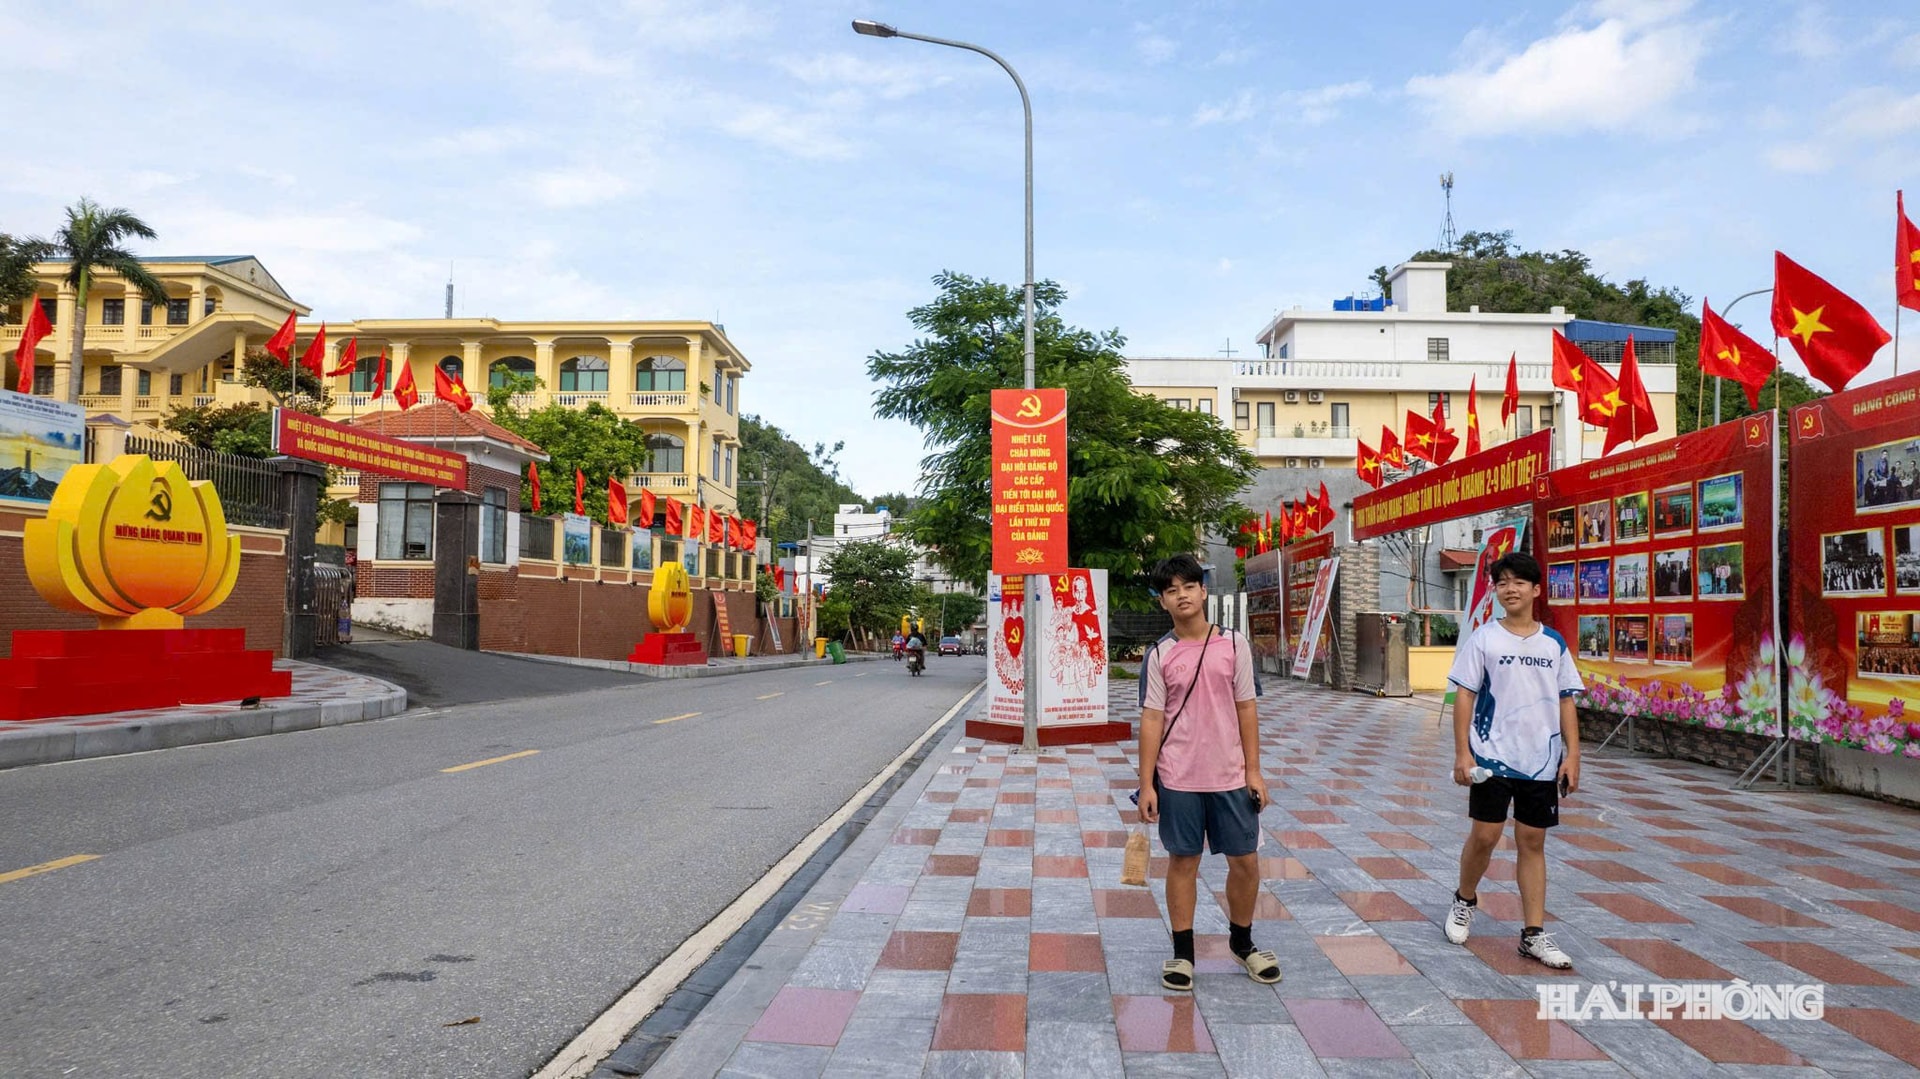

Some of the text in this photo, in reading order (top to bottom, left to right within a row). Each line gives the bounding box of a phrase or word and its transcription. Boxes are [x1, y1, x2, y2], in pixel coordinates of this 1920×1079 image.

[1853, 388, 1916, 416] ĐẢNG CỘNG
[1011, 433, 1047, 445] NHIỆT LIỆT
[1009, 446, 1051, 458] CHÀO MỪNG
[1001, 460, 1058, 474] ĐẠI HỘI ĐẢNG BỘ
[1014, 475, 1028, 485] CÁC
[1376, 498, 1389, 523] CÁCH
[1388, 496, 1403, 523] MẠNG
[1403, 487, 1420, 516] THÁNG
[1421, 482, 1433, 511] TÁM
[1433, 479, 1442, 508] VÀ
[1442, 469, 1460, 508] QUỐC
[1460, 467, 1485, 501] KHÁNH
[1486, 466, 1499, 495] 2-9
[1500, 451, 1516, 491] BẤT
[1517, 449, 1537, 491] DIỆT
[1002, 487, 1057, 501] TIẾN TỚI ĐẠI HỘI
[995, 501, 1065, 515] ĐẠI BIỂU TOÀN QUỐC
[1009, 515, 1051, 527] LẦN THỨ XIV
[115, 523, 203, 543] MỪNG ĐẢNG QUANG VINH
[1011, 528, 1049, 541] CỦA ĐẢNG!
[1518, 656, 1554, 668] YONEX
